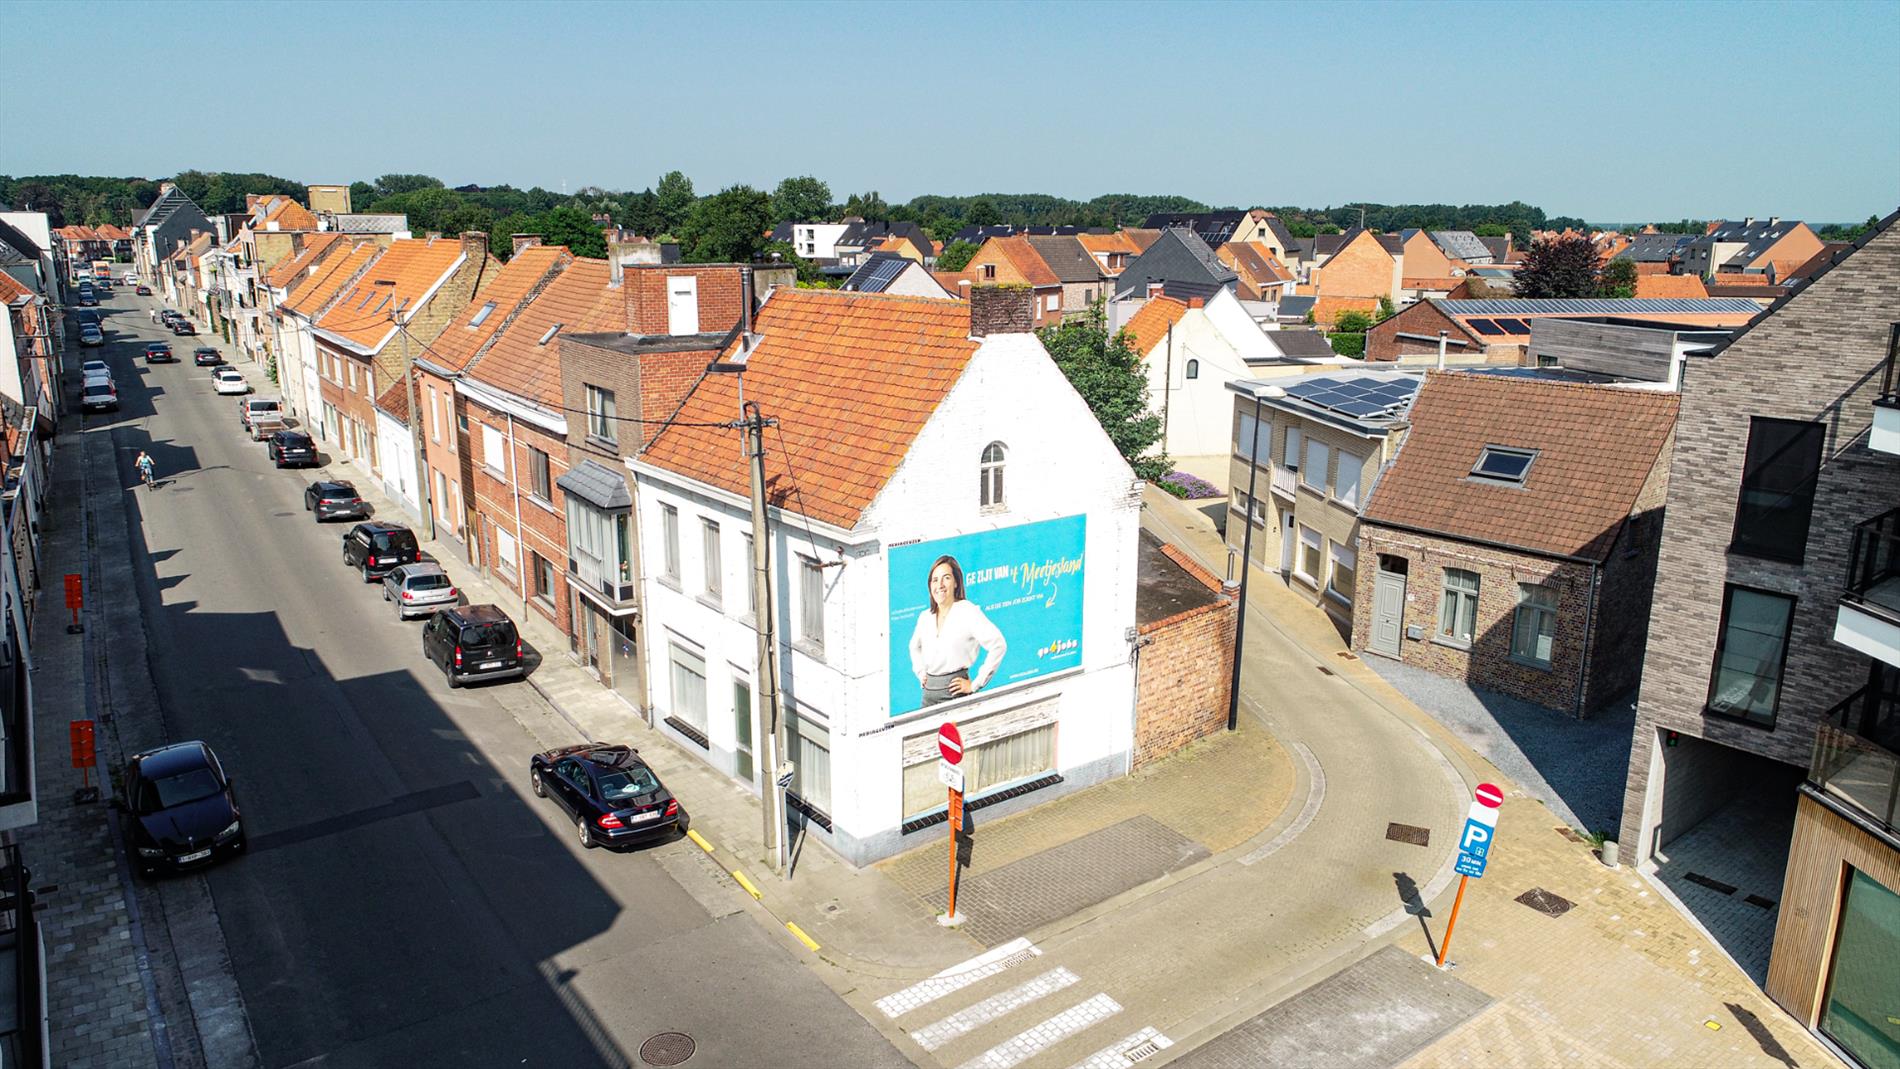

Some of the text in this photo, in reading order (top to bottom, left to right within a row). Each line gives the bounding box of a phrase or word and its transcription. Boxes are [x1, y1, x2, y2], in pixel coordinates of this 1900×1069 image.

[966, 572, 976, 587] GE
[977, 567, 993, 584] ZIJT
[994, 565, 1009, 580] VAN
[1020, 553, 1084, 595] Meetjesland
[1036, 639, 1078, 659] go4jobs
[1463, 824, 1488, 848] P
